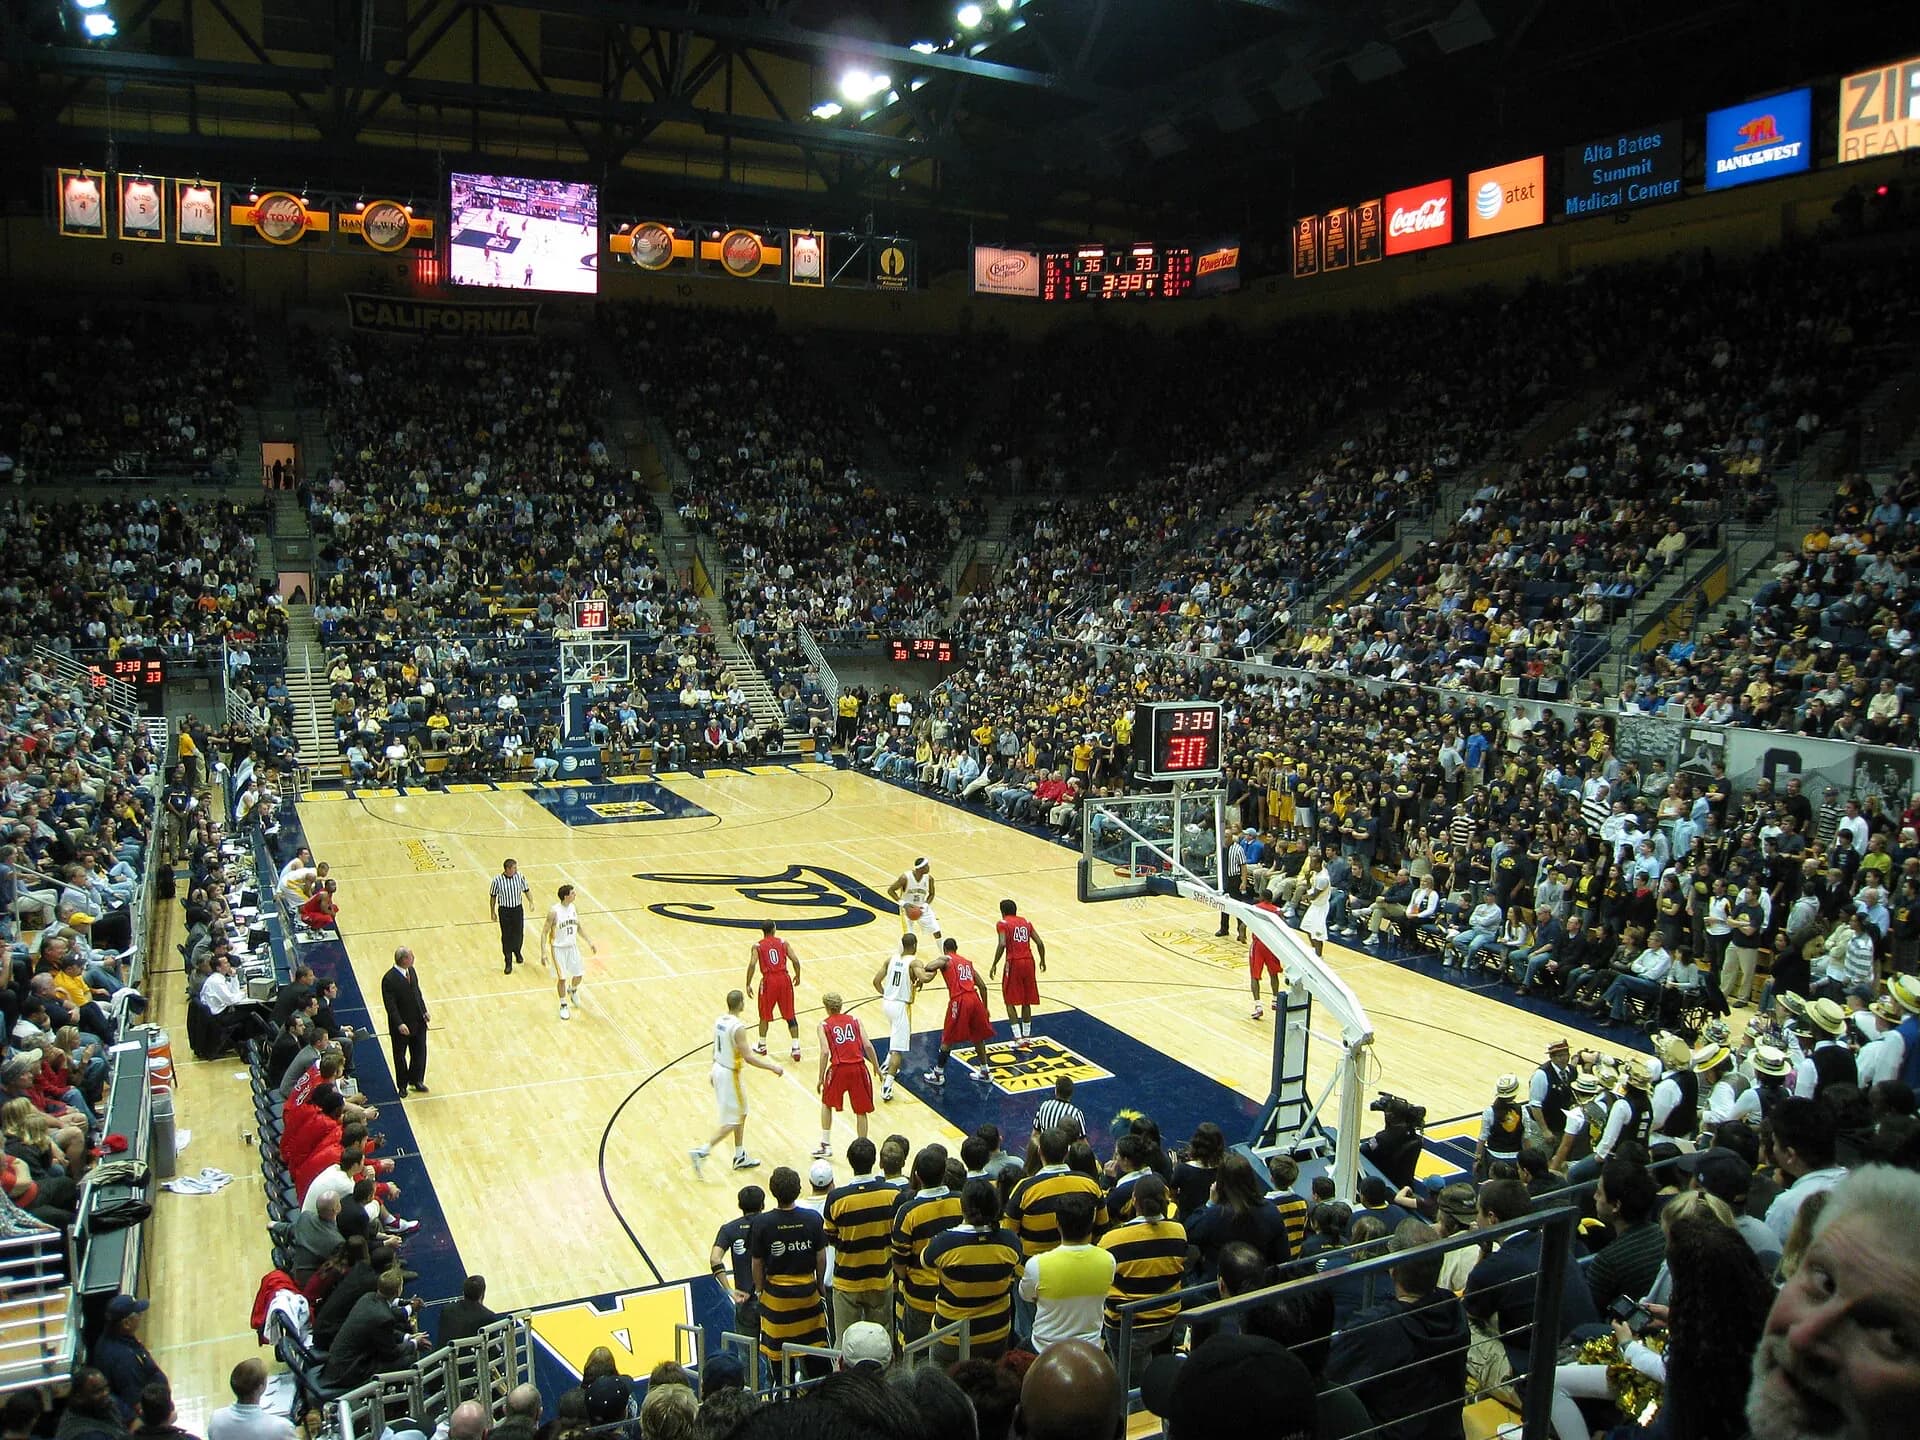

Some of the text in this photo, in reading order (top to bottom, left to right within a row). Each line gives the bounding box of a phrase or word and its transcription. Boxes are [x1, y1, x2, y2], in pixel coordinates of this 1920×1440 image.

[1584, 133, 1662, 164] Alta Bates
[1845, 124, 1919, 161] REAL
[1716, 154, 1751, 173] BANK
[1764, 142, 1802, 162] WEST
[1592, 158, 1652, 184] Summit
[1505, 182, 1536, 204] at&t
[1566, 179, 1680, 215] Medical Center
[139, 203, 146, 214] 5
[194, 208, 203, 219] 11
[271, 214, 313, 225] TOYOTA
[1389, 197, 1448, 238] Coca-Cola
[1085, 260, 1101, 273] 35
[1136, 257, 1153, 271] 33
[1200, 253, 1236, 272] PowerBar
[1102, 274, 1142, 290] 3:39
[357, 301, 530, 331] CALIFORNIA
[584, 602, 604, 612] 3:39
[583, 613, 601, 626] 30
[914, 640, 934, 650] 3:39
[895, 650, 907, 660] 35
[938, 651, 950, 661] 33
[115, 661, 141, 673] 3:39
[146, 671, 161, 683] 33
[1172, 711, 1213, 731] 3:39
[1168, 737, 1205, 767] 30
[579, 759, 596, 767] at&t
[1193, 891, 1226, 911] State Farm
[1014, 926, 1028, 942] 43
[769, 948, 779, 965] 0
[834, 1024, 855, 1044] 34
[788, 1239, 812, 1251] at&t
